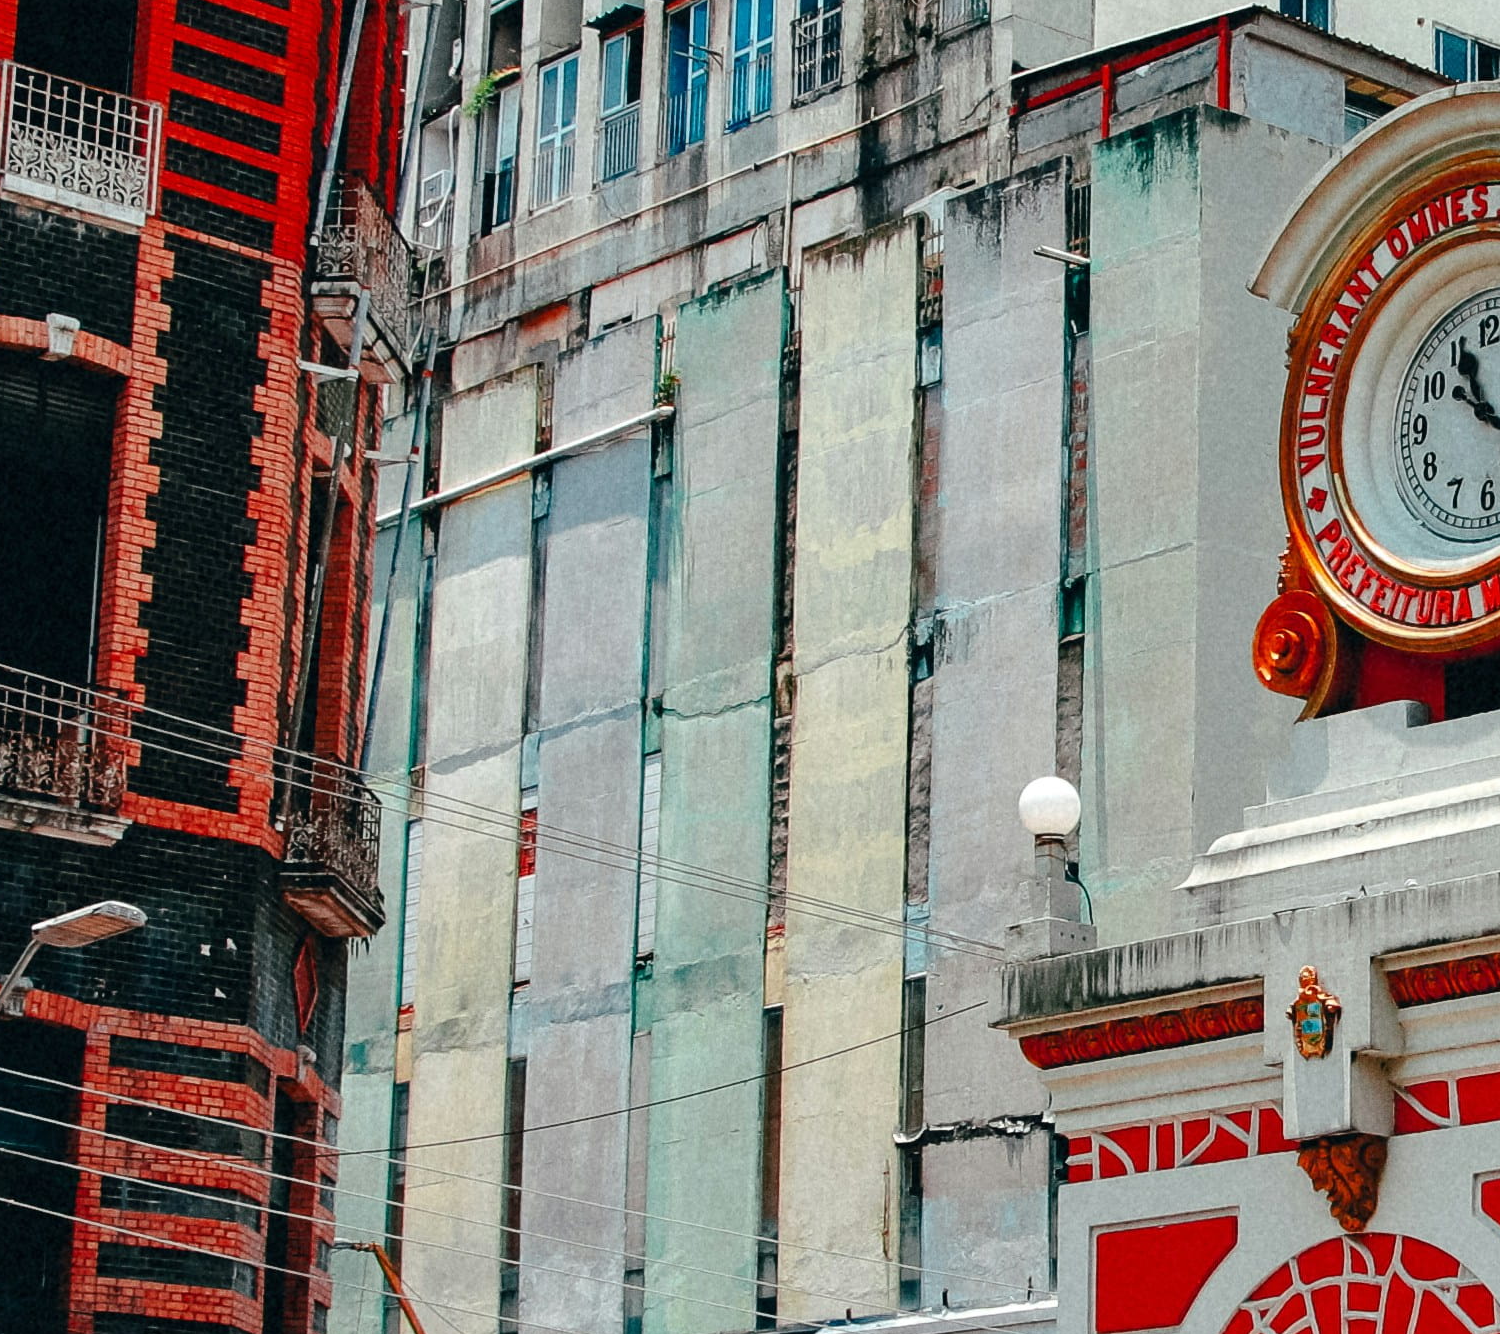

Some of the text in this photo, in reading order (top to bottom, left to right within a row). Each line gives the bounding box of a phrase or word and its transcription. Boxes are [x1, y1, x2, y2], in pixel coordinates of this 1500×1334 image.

[1479, 314, 1500, 349] 12
[1299, 252, 1383, 476] VULNERANT
[1423, 370, 1446, 404] 10
[1412, 413, 1428, 446] 9
[1423, 451, 1438, 482] 8
[1447, 477, 1464, 509] 7
[1480, 479, 1495, 511] 6
[1315, 517, 1474, 625] PREFEITURA
